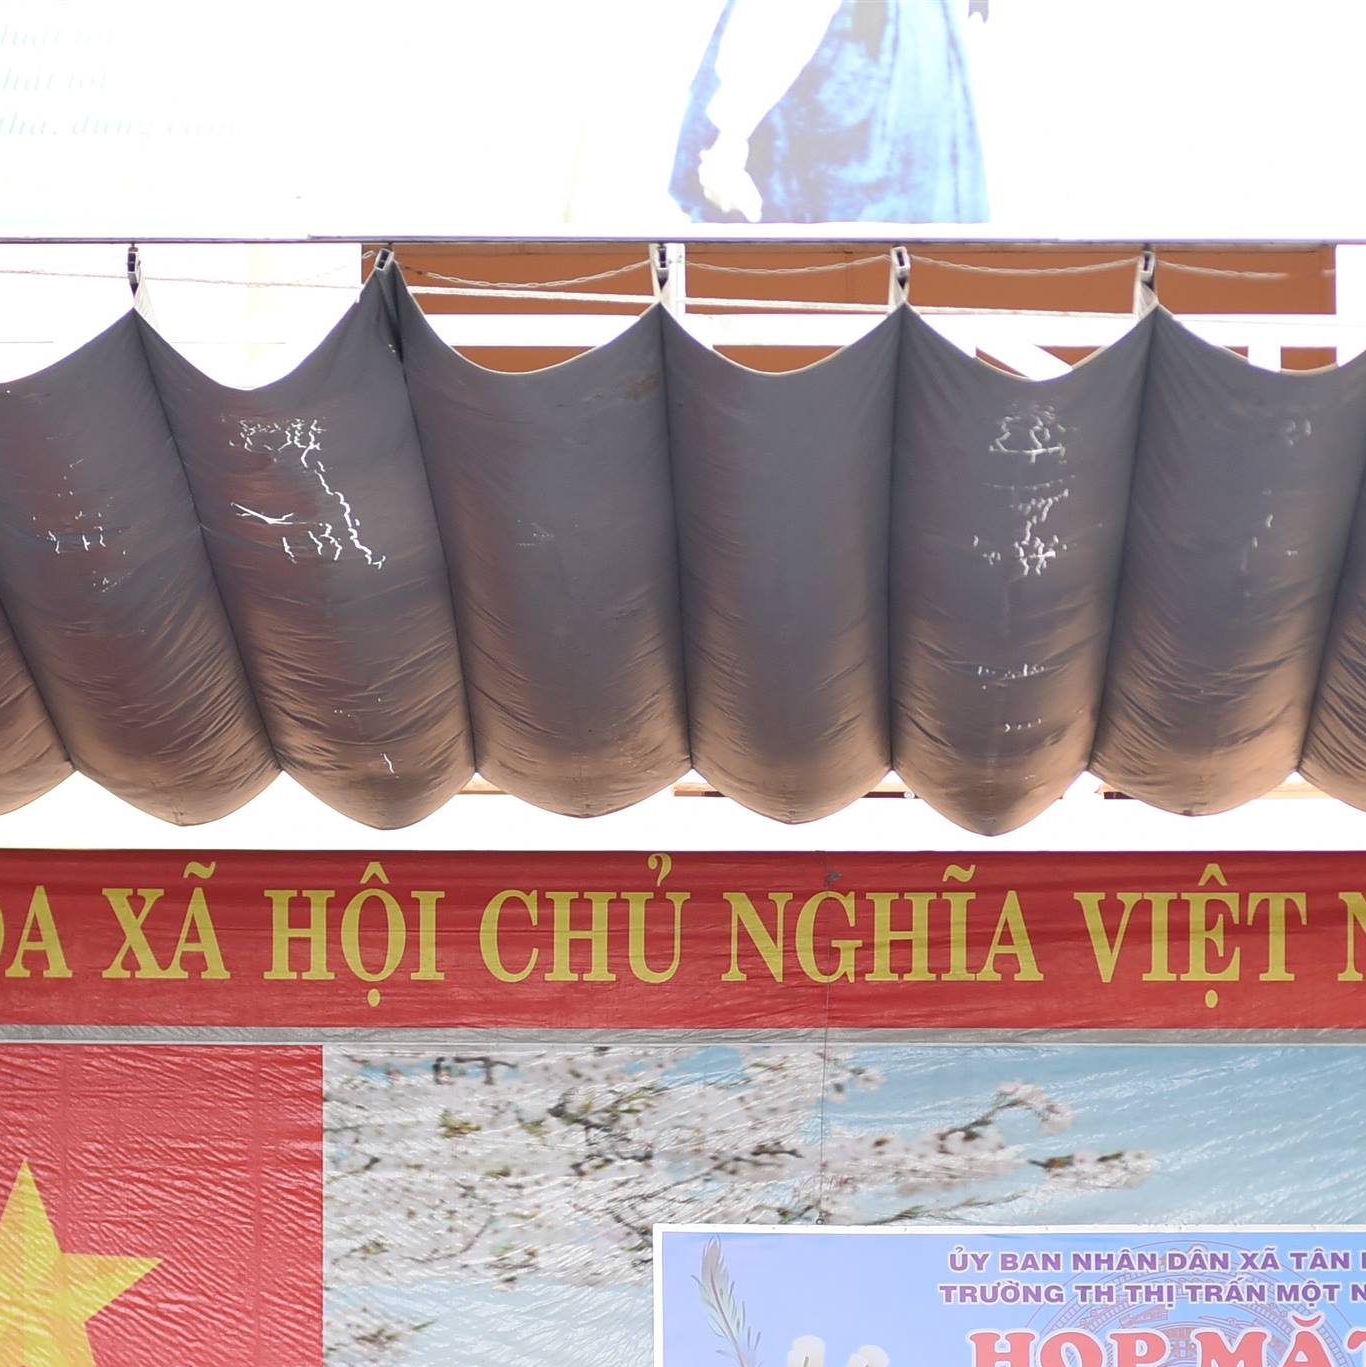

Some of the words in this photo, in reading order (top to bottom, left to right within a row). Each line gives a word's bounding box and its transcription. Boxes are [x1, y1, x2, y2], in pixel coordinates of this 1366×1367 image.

[102, 861, 228, 980] XÃ
[265, 862, 445, 1006] HỘI
[480, 854, 691, 981] CHỦ
[722, 864, 1043, 982] NGHĨA
[1075, 862, 1307, 1008] VIỆT
[950, 1246, 990, 1272] ỦY
[1001, 1253, 1062, 1271] BAN
[1072, 1247, 1160, 1271] NHÂN
[1168, 1246, 1230, 1271] DÂN
[1240, 1247, 1282, 1270] XÃ
[1293, 1246, 1354, 1270] TÂN
[939, 1279, 1065, 1304] TRƯỜNG
[1074, 1285, 1115, 1303] TH
[1124, 1284, 1175, 1309] THỊ
[1185, 1277, 1267, 1303] TRẤN
[1277, 1277, 1341, 1307] MỘT
